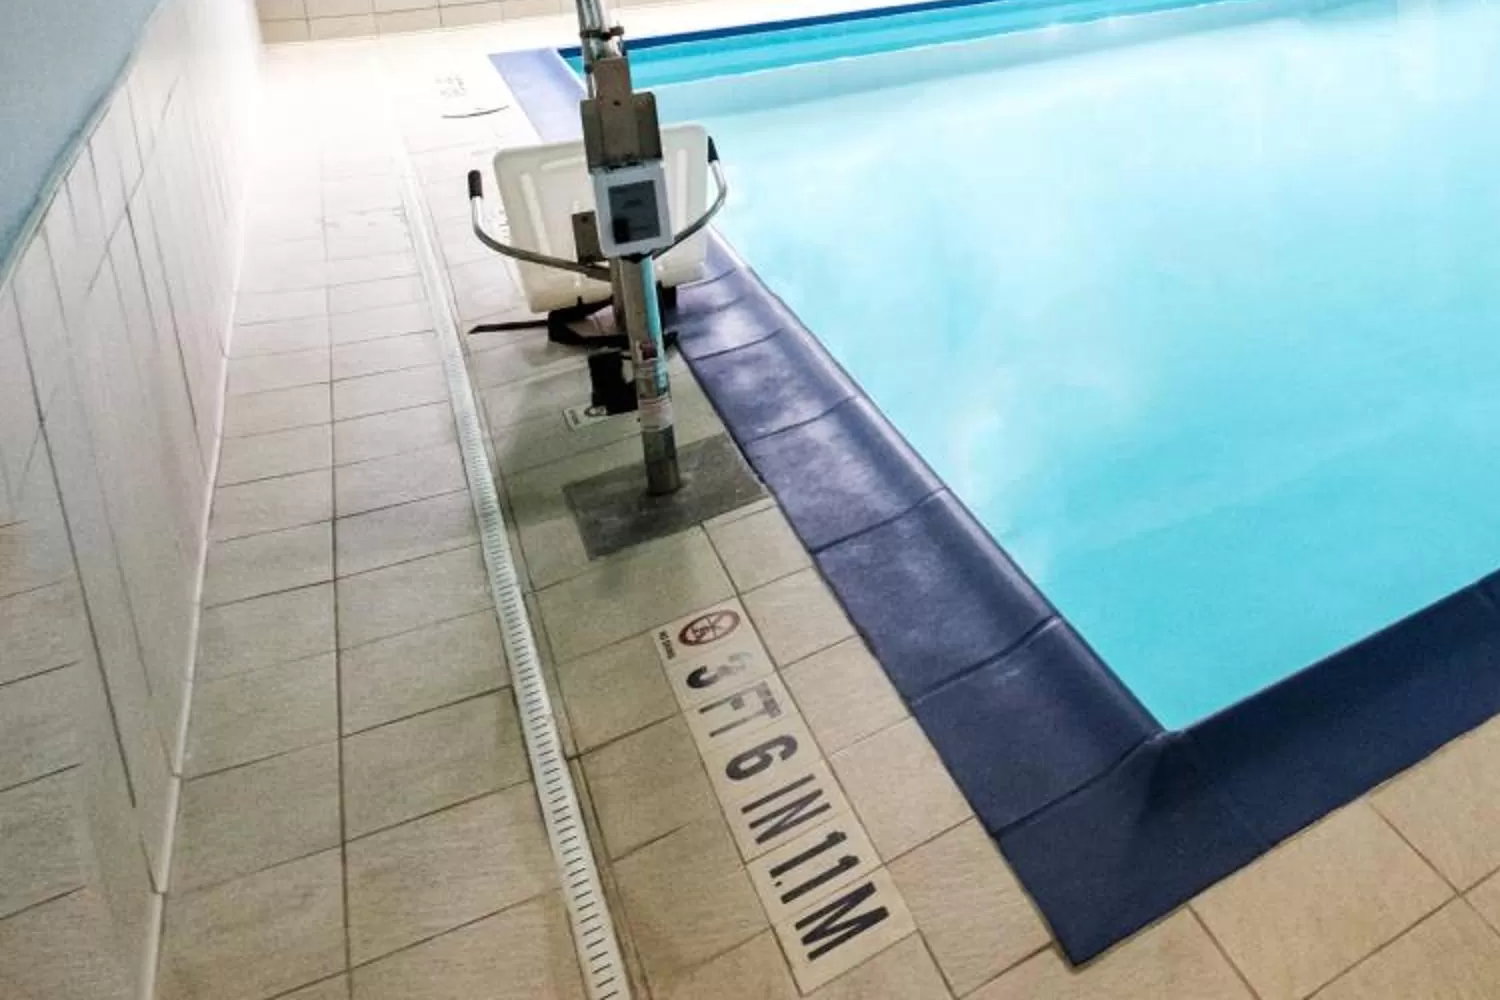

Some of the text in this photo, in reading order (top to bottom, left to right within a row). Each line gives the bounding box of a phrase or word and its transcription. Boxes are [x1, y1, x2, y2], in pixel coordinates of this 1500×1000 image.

[686, 651, 751, 689] 3
[699, 680, 782, 738] FT
[725, 734, 798, 781] 6
[741, 773, 831, 844] IN
